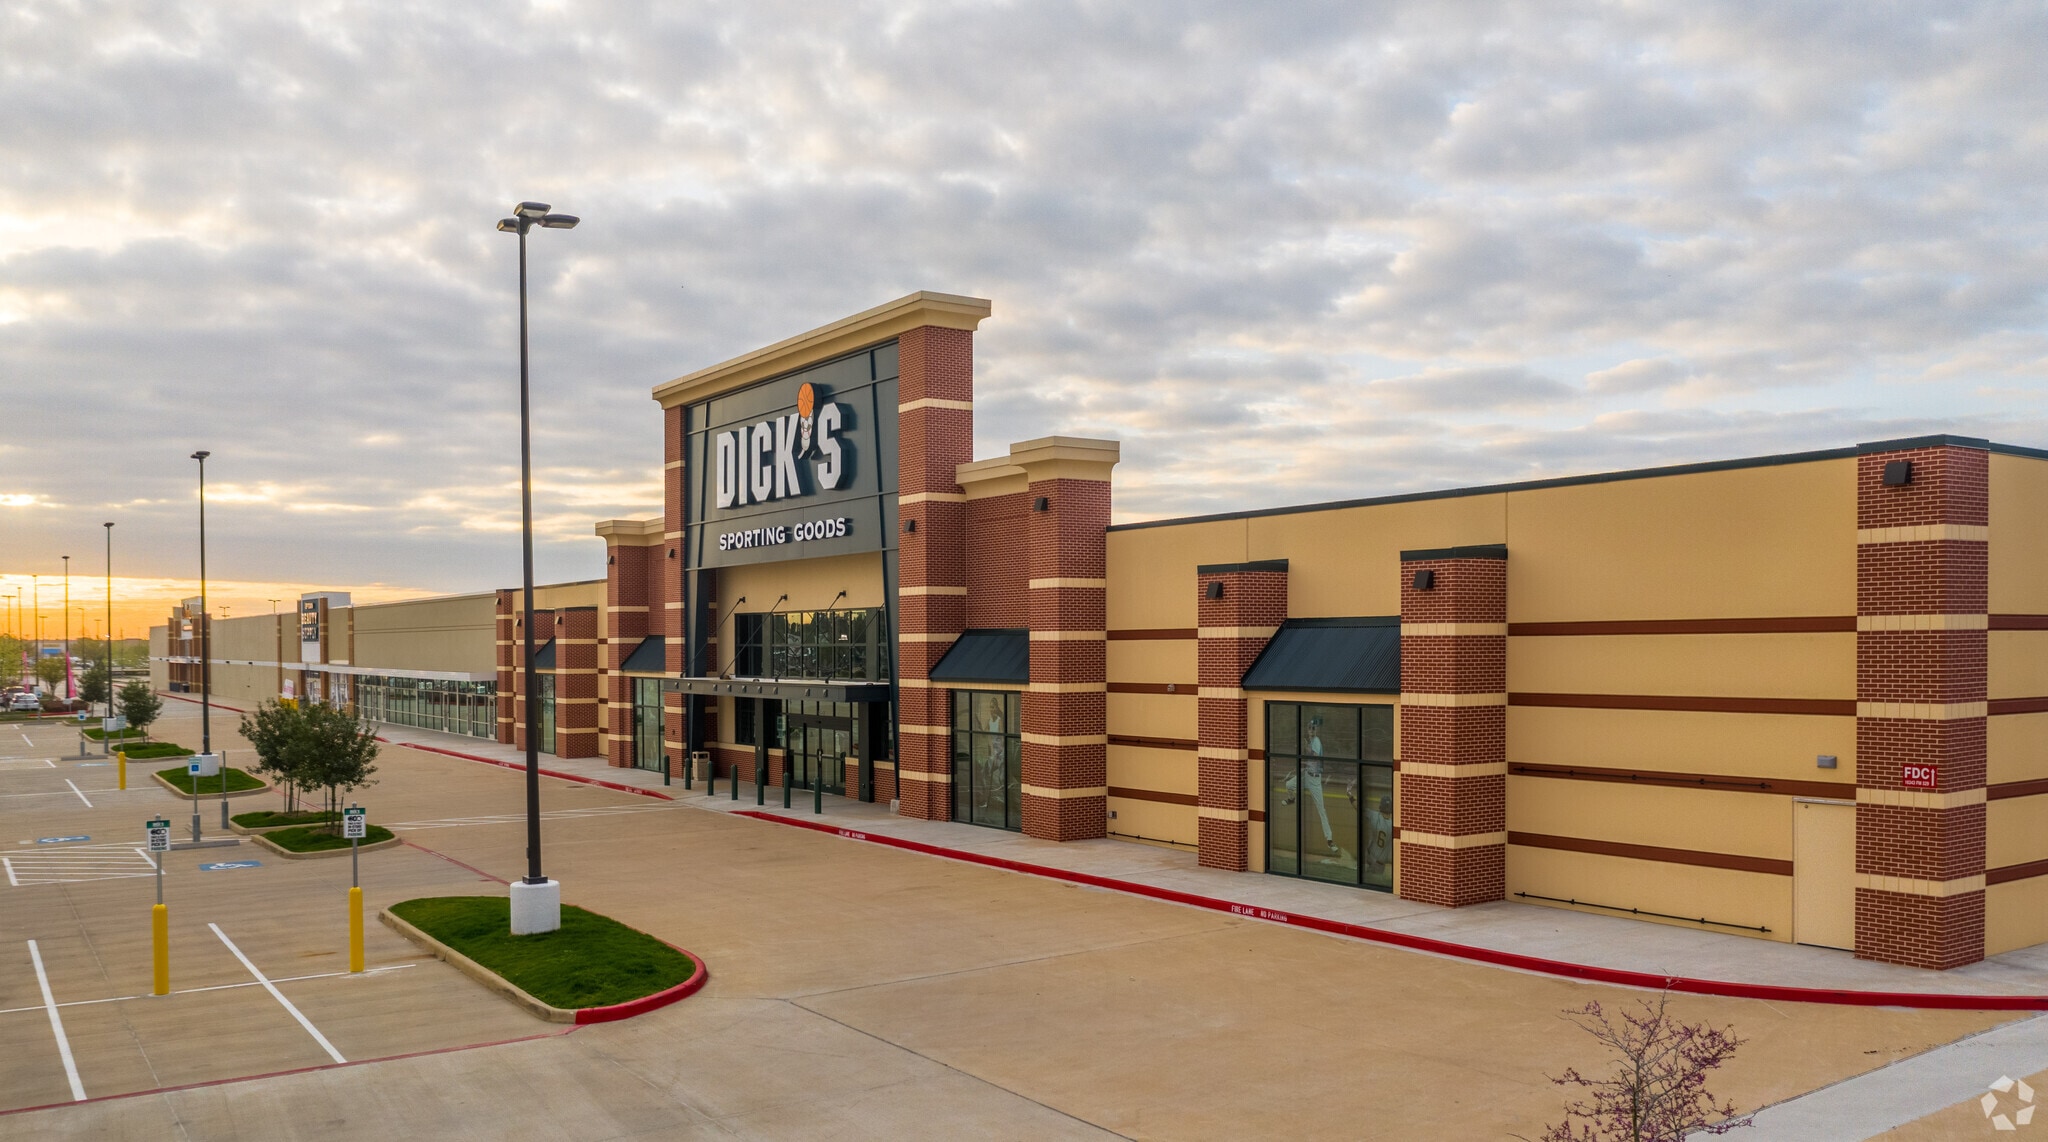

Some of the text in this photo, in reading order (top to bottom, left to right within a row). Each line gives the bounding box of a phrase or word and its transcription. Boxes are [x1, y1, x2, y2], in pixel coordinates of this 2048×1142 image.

[717, 383, 842, 509] DICK'S
[719, 517, 846, 551] SPORTING GOODS
[1904, 766, 1930, 780] FDC
[1377, 830, 1387, 849] 6
[1232, 905, 1241, 914] FIRE
[1242, 907, 1254, 916] LANE
[1267, 912, 1288, 922] PARKING
